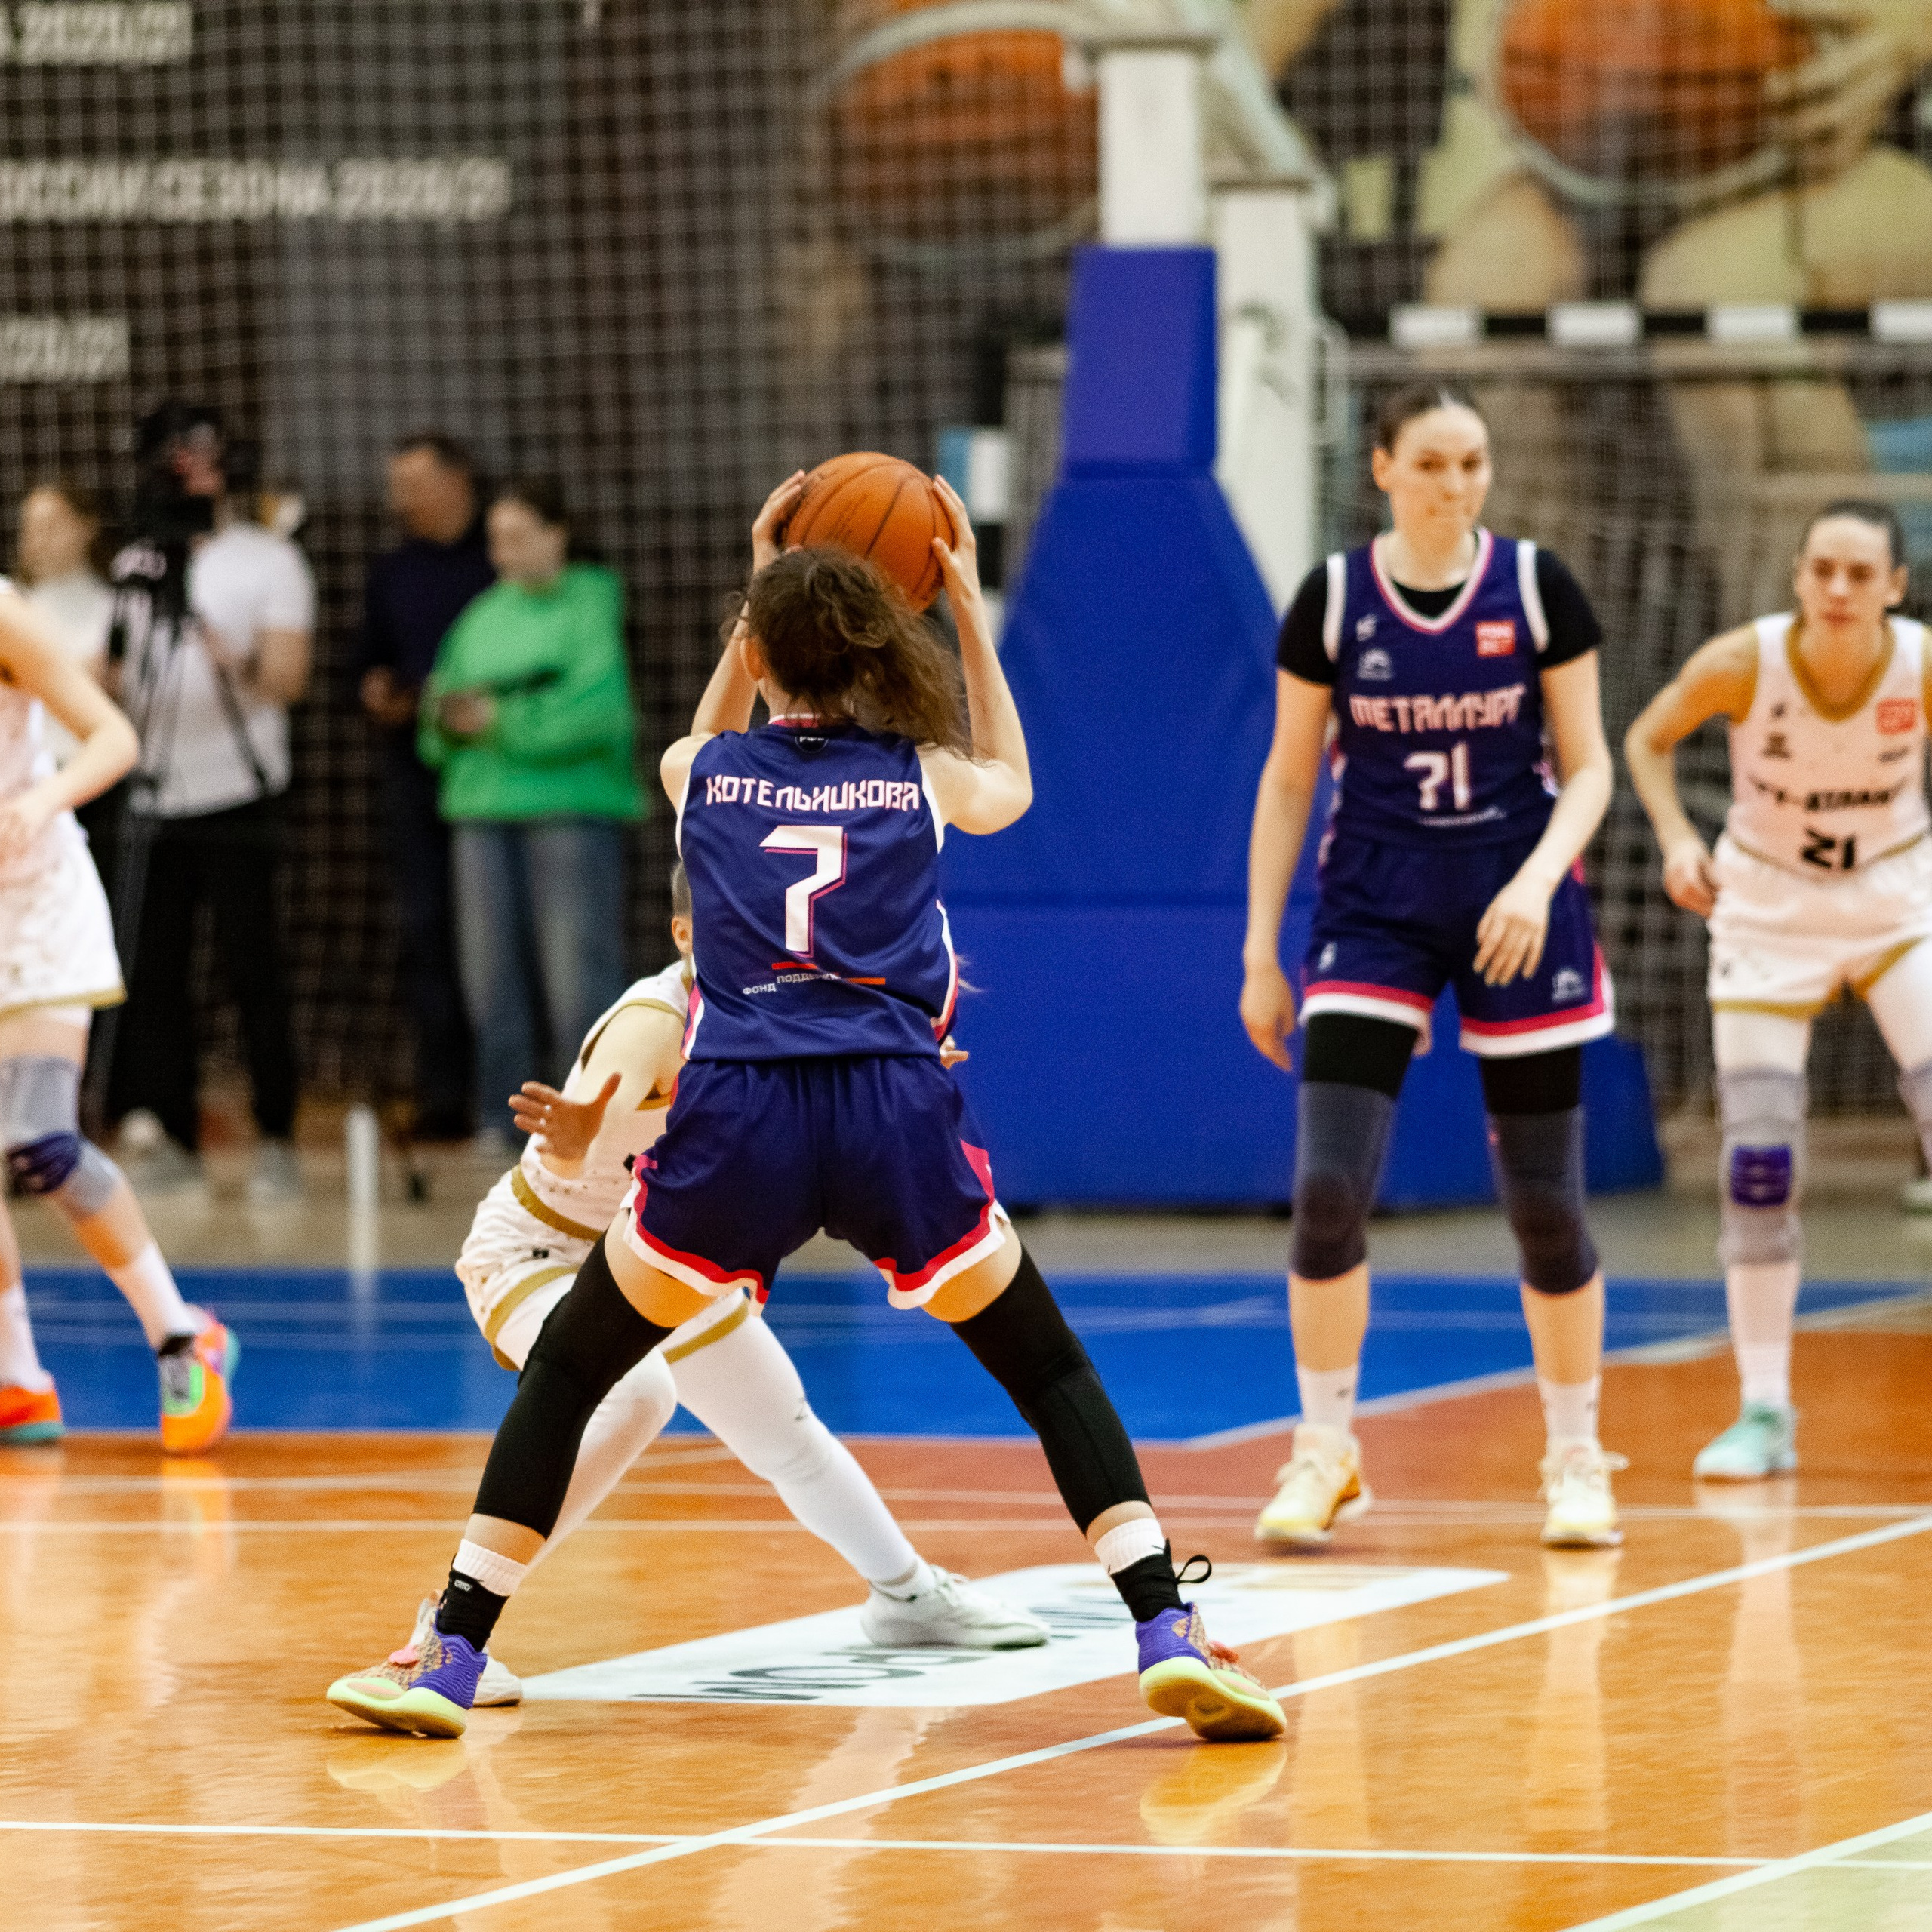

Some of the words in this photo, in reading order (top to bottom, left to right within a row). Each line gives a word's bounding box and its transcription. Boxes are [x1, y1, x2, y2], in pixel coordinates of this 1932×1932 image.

[152, 157, 328, 220] СЕЗОНА
[706, 774, 920, 813] КОТЕЛЬНИКОВА
[1404, 740, 1470, 811] 71
[1801, 827, 1857, 869] 21
[759, 825, 847, 957] 7
[743, 983, 777, 995] ФОНД
